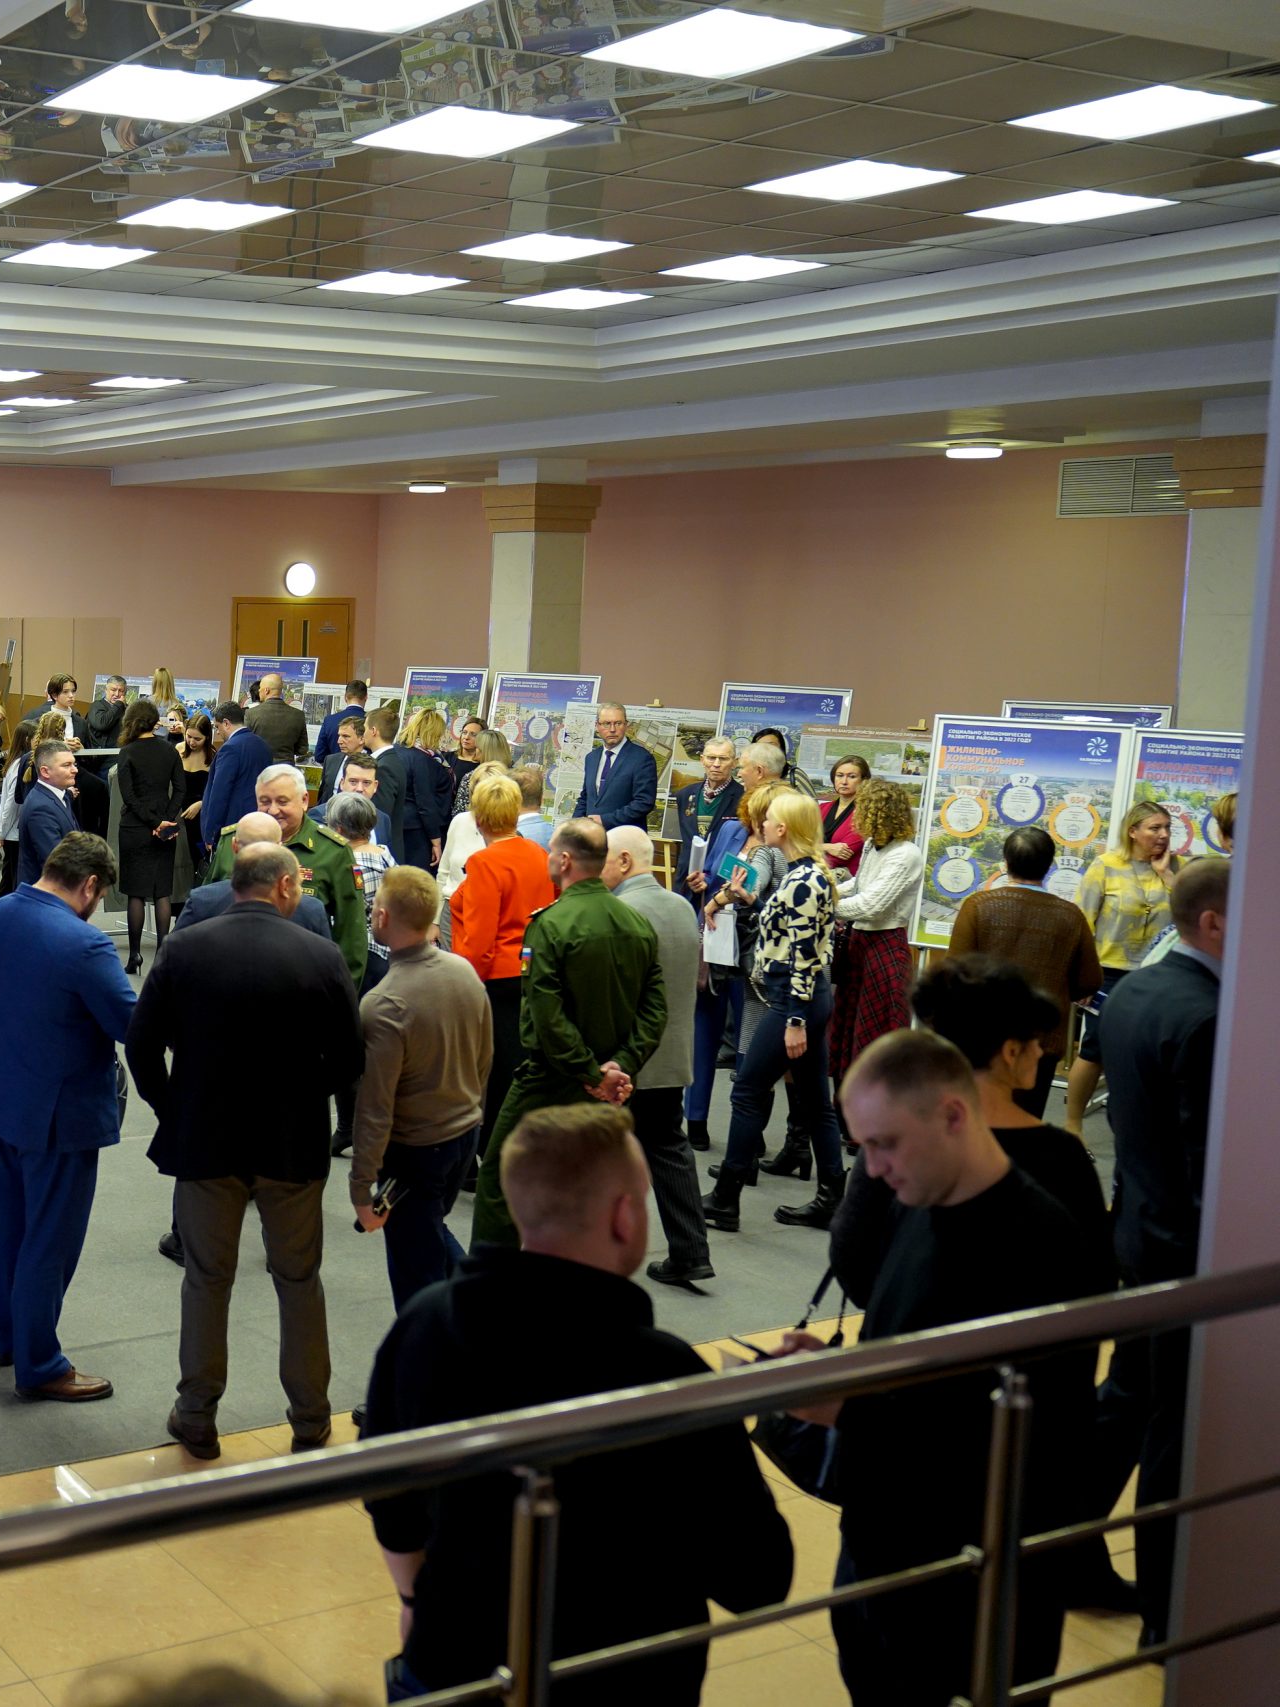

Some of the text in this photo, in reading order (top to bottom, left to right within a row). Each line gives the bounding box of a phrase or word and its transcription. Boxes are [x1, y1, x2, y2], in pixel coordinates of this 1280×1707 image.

[730, 705, 767, 714] ЭКОЛОГИЯ
[948, 728, 1032, 738] СОЦИАЛЬНО-ЭКОНОМИЧЕСКОЕ
[947, 745, 1002, 756] ЖИЛИЩНО-
[946, 754, 1025, 766] КОММУНАЛЬНОЕ
[1144, 771, 1213, 785] ПОЛИТИКА
